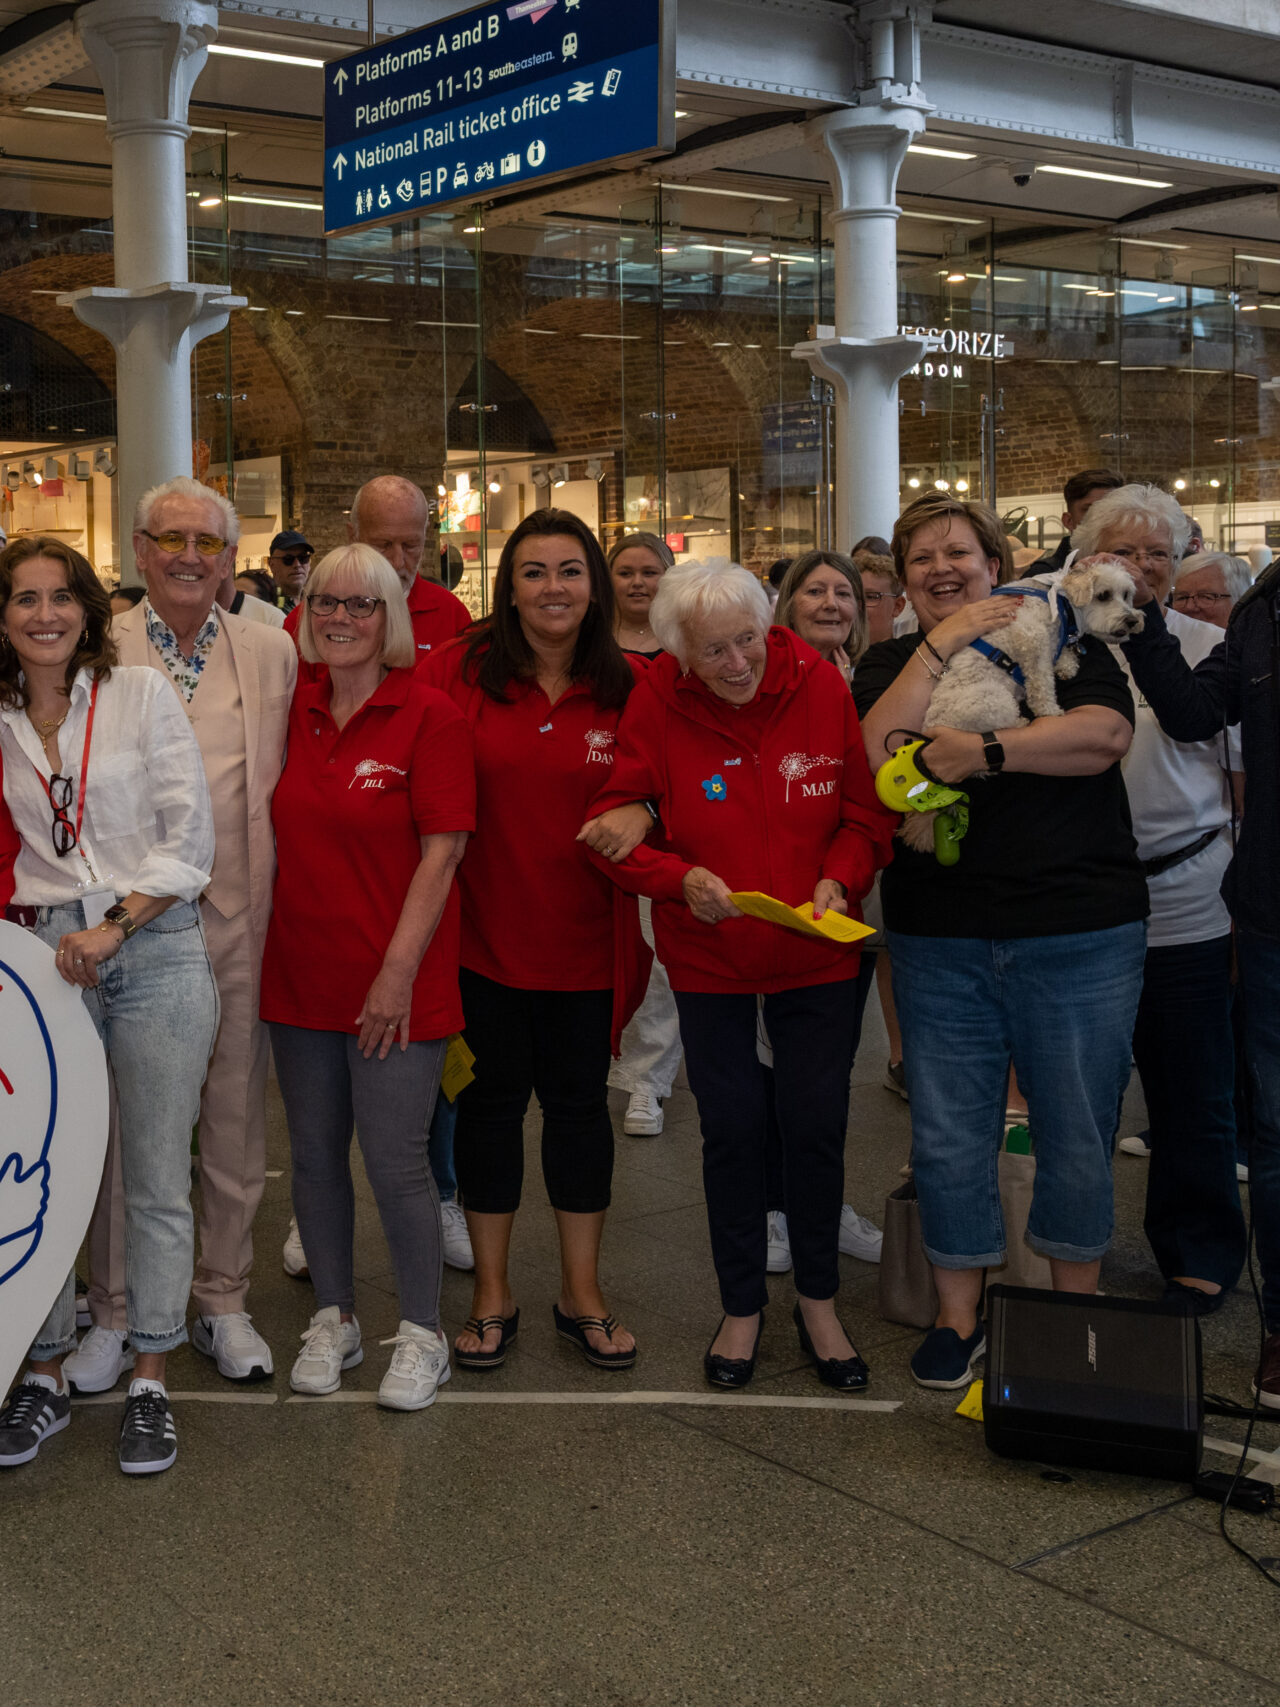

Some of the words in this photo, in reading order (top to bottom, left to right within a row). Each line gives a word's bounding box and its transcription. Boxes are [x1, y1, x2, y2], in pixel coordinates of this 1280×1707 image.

[356, 44, 431, 85] Platforms
[435, 34, 448, 57] A
[451, 20, 482, 52] and
[487, 15, 499, 39] B
[355, 89, 431, 128] Platforms
[437, 66, 483, 101] 11-13
[355, 133, 418, 171] National
[423, 121, 455, 151] Rail
[459, 107, 506, 139] ticket
[511, 93, 561, 124] office
[360, 778, 386, 789] JILL
[1088, 1324, 1097, 1372] BOSE
